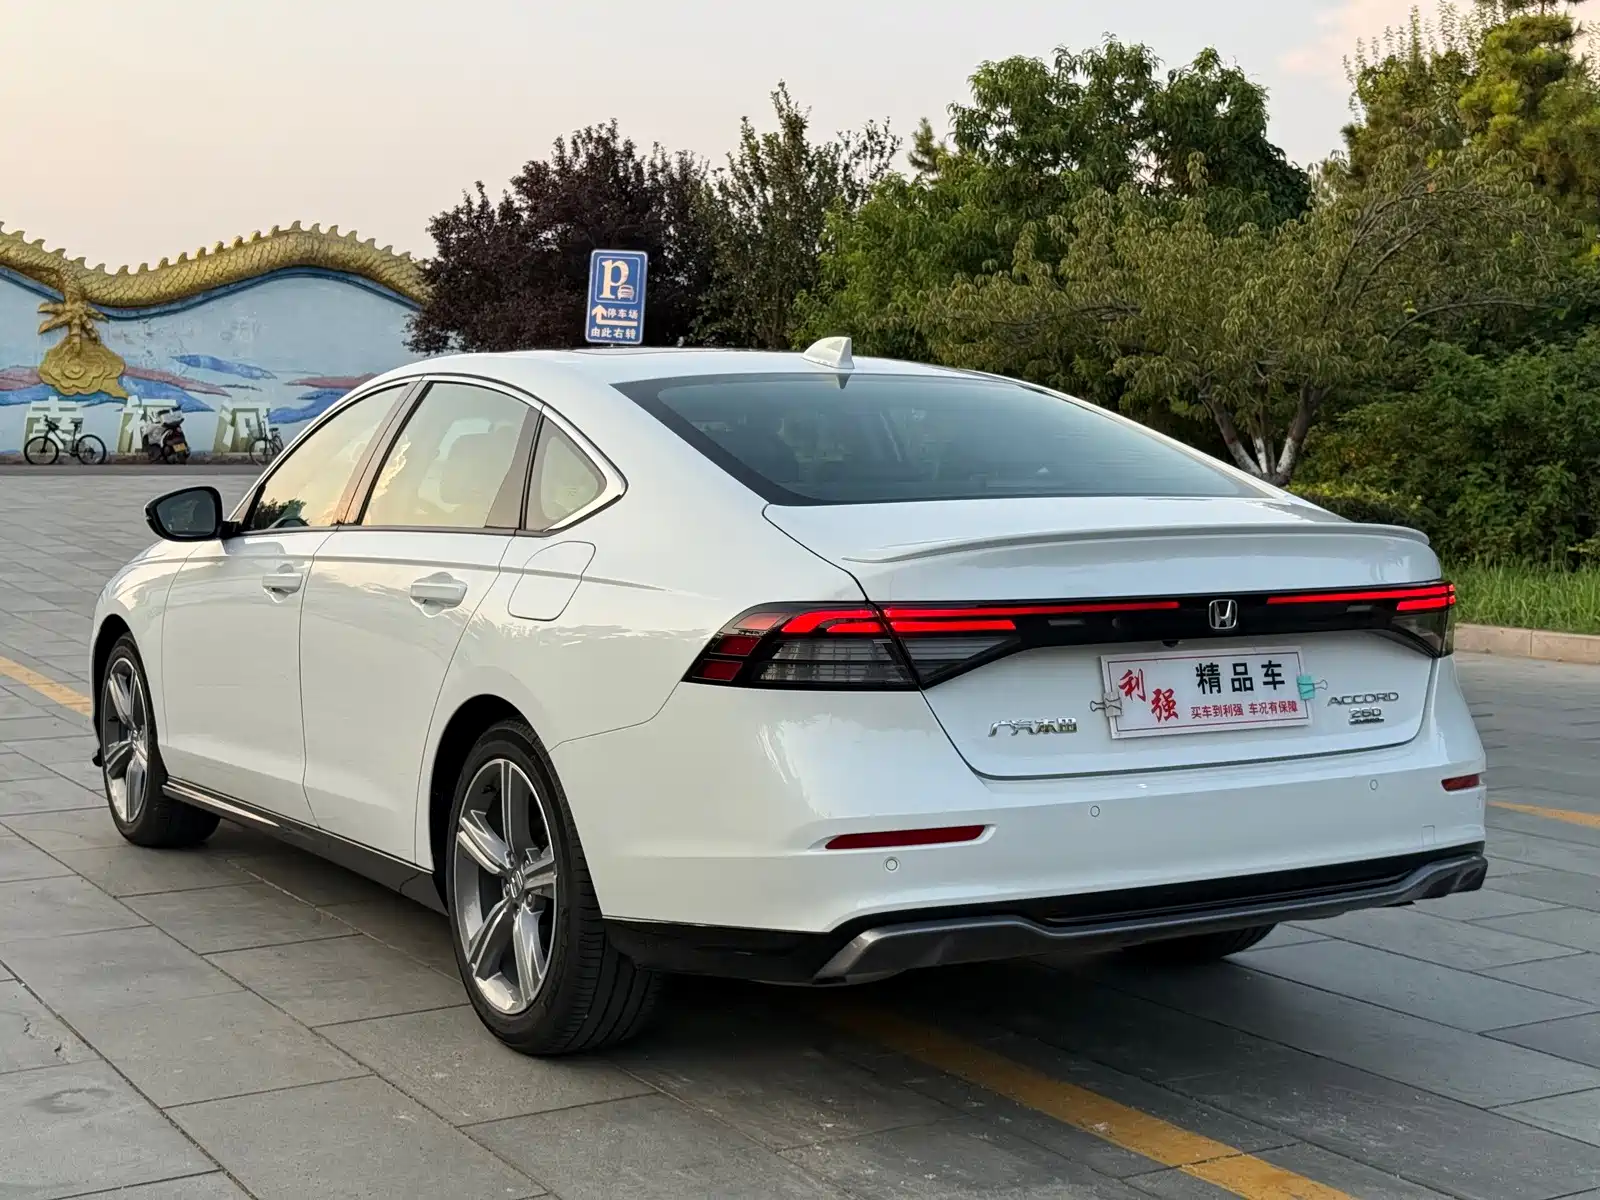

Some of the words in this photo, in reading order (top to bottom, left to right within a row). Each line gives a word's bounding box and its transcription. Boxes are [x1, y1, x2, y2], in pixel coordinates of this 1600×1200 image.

[607, 308, 638, 320] 停车场
[591, 327, 636, 340] 由此右转
[1195, 660, 1286, 695] 精品车
[1118, 668, 1179, 723] 利强
[1326, 692, 1399, 707] ACCORD
[1190, 703, 1244, 719] 买车到利强
[1248, 700, 1298, 714] 车况有保障
[988, 717, 1077, 737] 广汽本田
